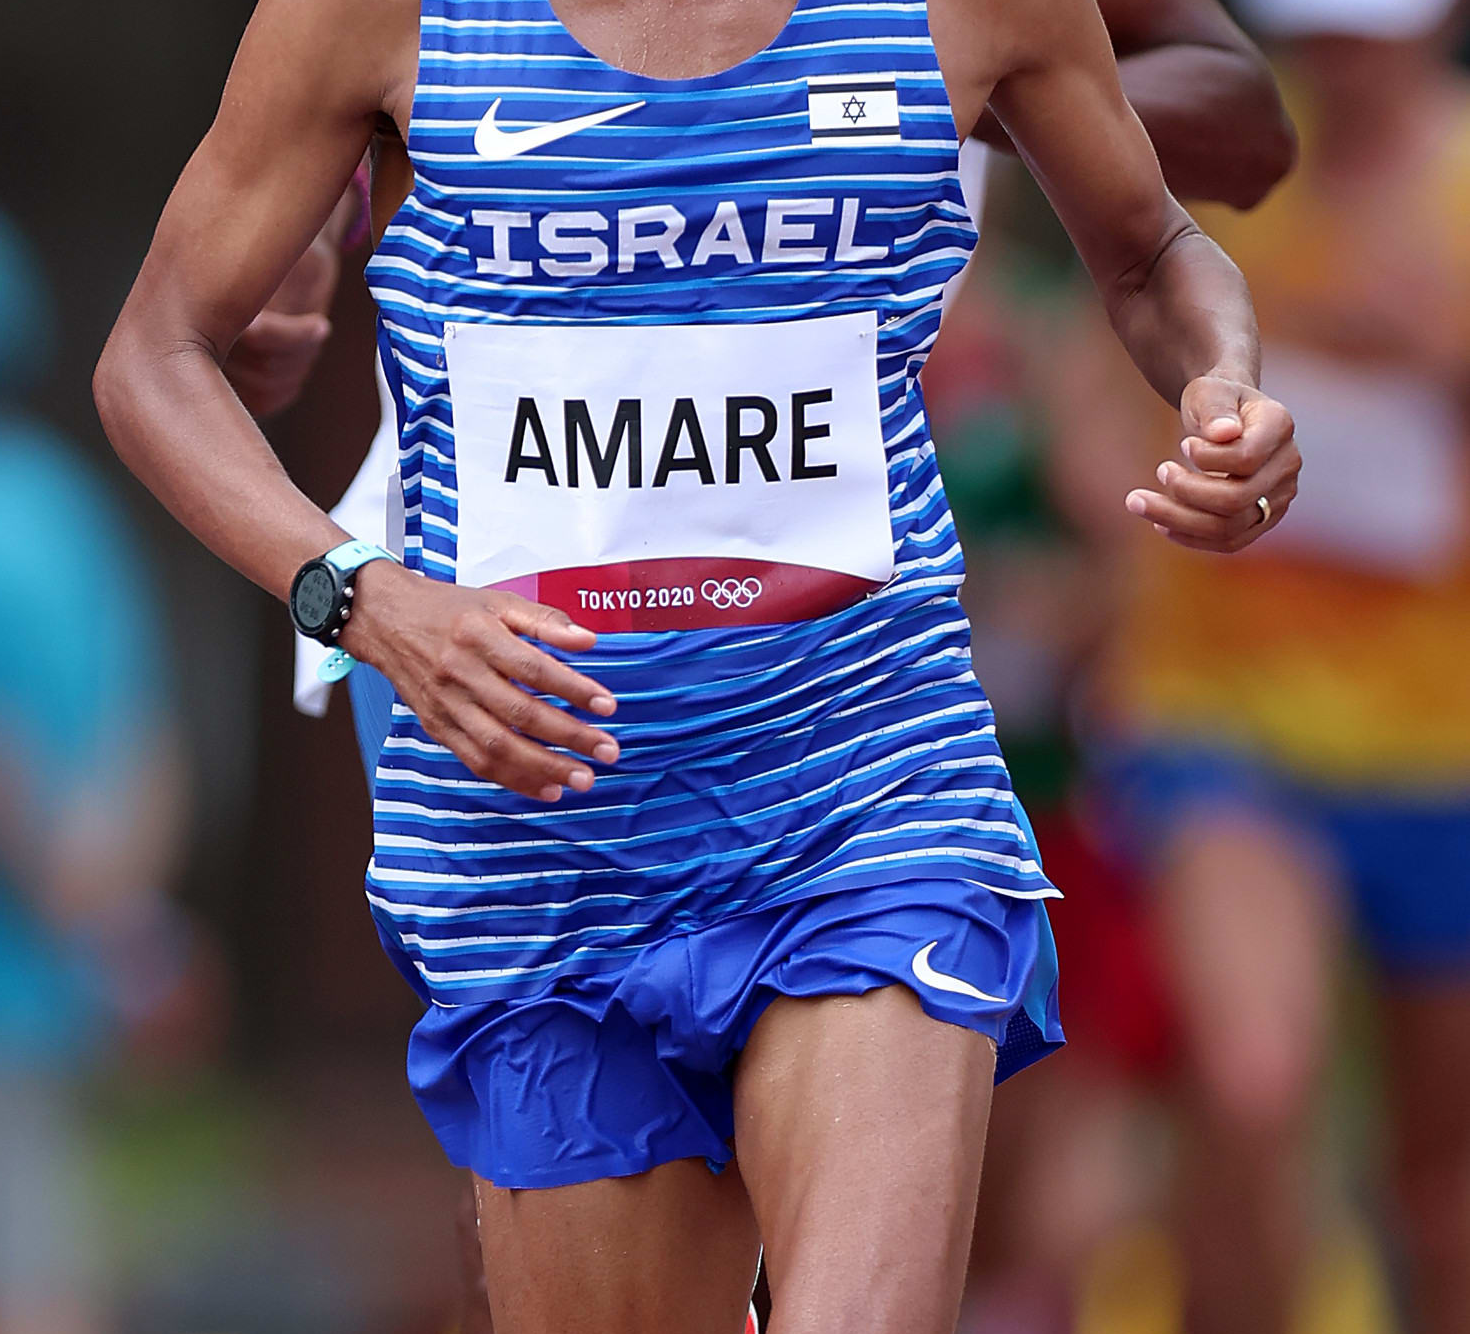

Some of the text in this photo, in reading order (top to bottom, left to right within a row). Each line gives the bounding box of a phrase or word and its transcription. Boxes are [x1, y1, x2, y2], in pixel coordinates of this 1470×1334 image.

[471, 197, 889, 278] ISRAEL
[504, 387, 838, 489] AMARE
[577, 586, 694, 610] TOKYO 2020
